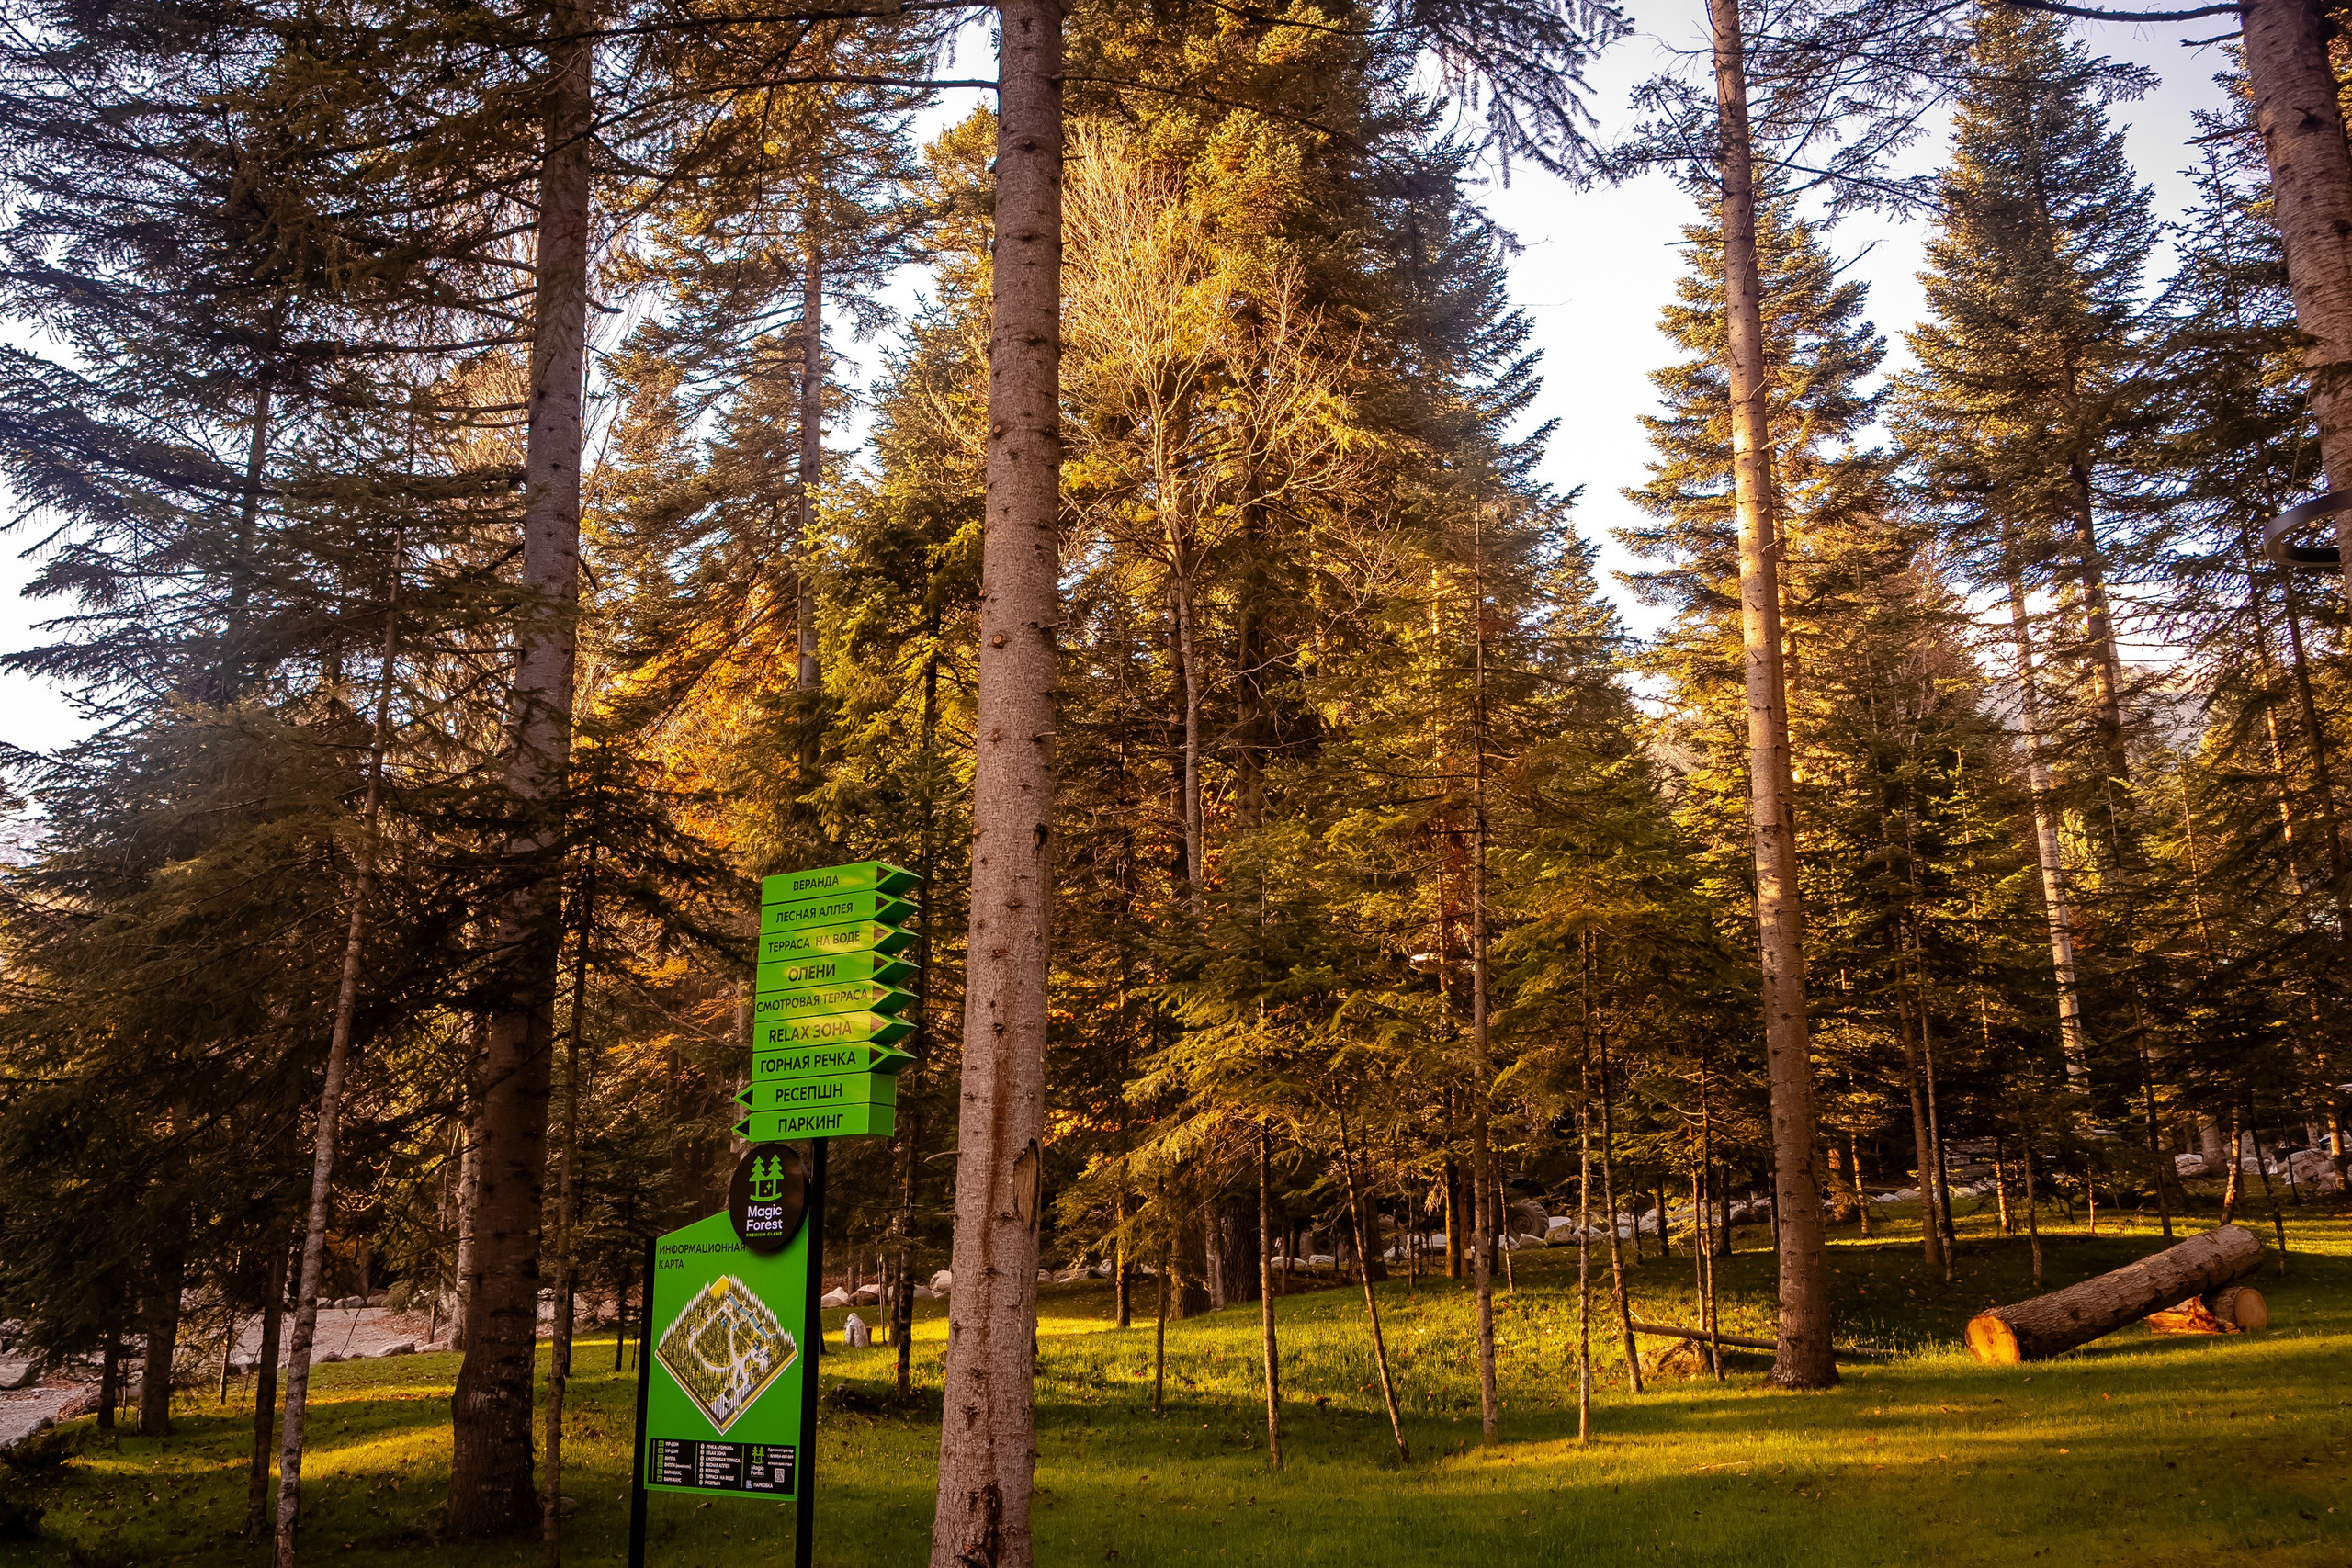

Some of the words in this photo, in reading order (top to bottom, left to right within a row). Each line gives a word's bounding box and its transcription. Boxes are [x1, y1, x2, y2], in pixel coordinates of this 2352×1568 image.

[793, 874, 839, 892] ВЕРАНДА
[776, 907, 817, 924] ЛЕСНАЯ
[819, 902, 854, 919] АЛЛЕЯ
[768, 938, 810, 953] ТЕРРАСА
[815, 935, 831, 947] НА
[833, 931, 861, 946] ВОДЕ
[788, 964, 836, 982] ОЛЕНИ
[756, 994, 820, 1013] СМОТРОВАЯ
[823, 988, 869, 1004] ТЕРРАСА
[769, 1025, 810, 1043] RELAX
[813, 1021, 852, 1039] ЗОНА
[760, 1055, 810, 1074] ГОРНАЯ
[814, 1051, 856, 1069] РЕЧКА
[775, 1083, 843, 1103] РЕСЕПШН
[778, 1113, 843, 1134] ПАРКИНГ
[747, 1203, 783, 1220] Magic
[746, 1219, 783, 1232] Forest
[659, 1242, 746, 1255] ИНФОРМАЦИОННАЯ
[658, 1259, 684, 1269] КАРТА
